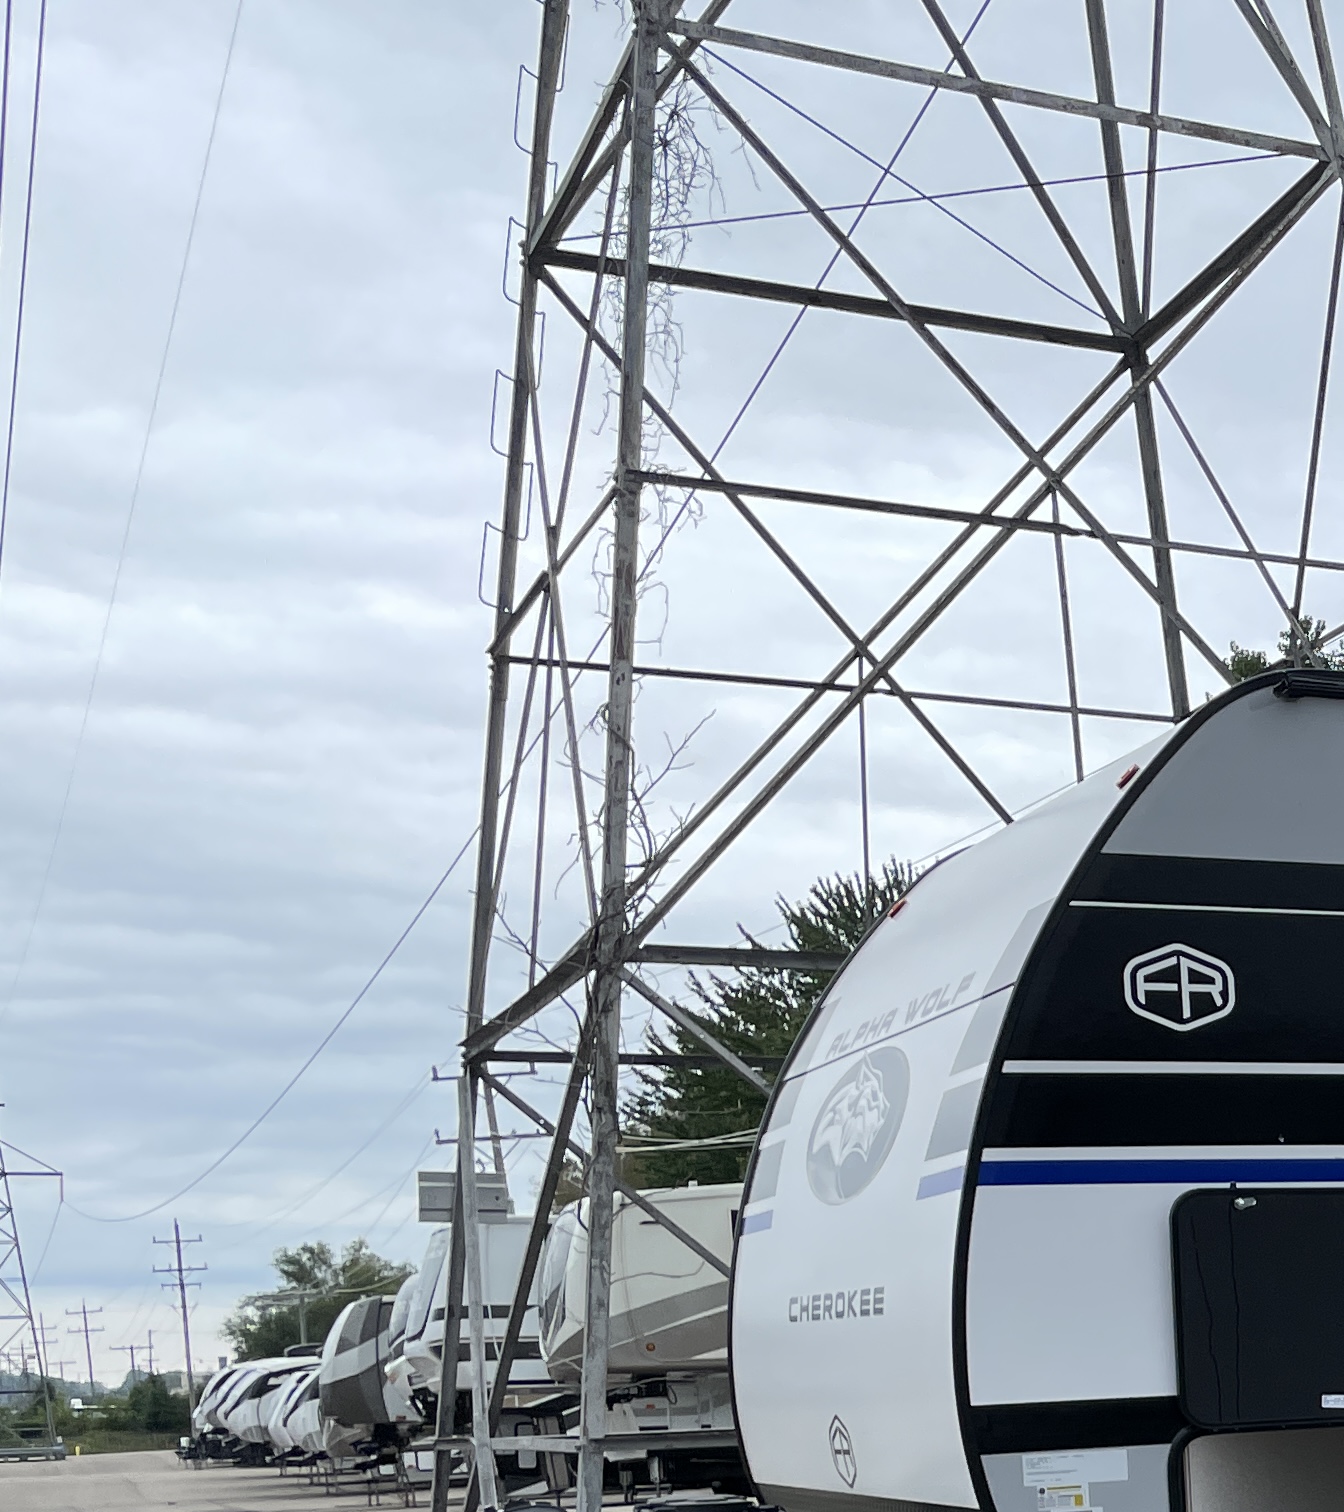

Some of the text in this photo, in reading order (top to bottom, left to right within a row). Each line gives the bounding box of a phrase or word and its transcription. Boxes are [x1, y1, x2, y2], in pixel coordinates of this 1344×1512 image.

[824, 970, 977, 1061] ALPHA WOLF
[1135, 954, 1225, 1020] FR
[788, 1286, 885, 1323] CHEROKEE
